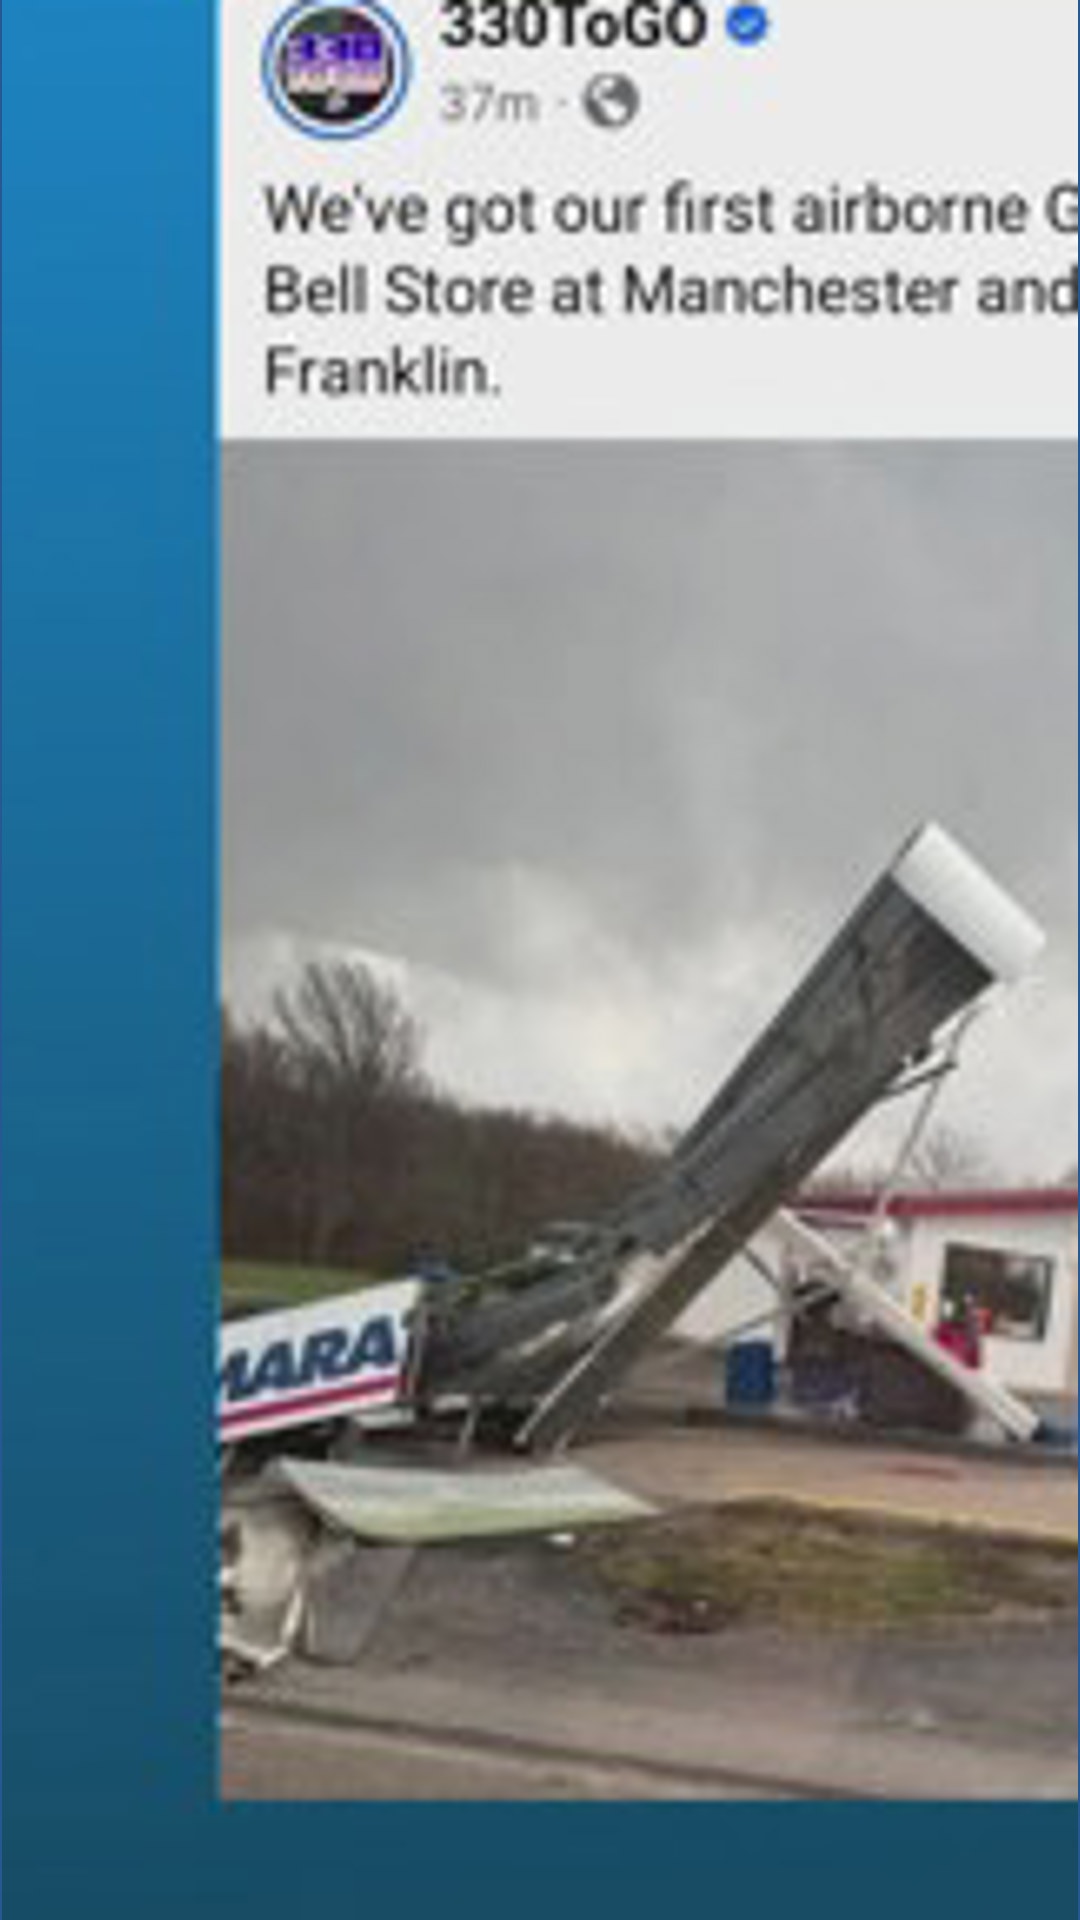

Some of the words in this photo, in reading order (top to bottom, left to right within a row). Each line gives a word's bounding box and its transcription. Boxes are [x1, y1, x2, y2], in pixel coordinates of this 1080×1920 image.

[440, 0, 707, 48] 330ToGO
[440, 84, 539, 121] 37m
[264, 184, 428, 234] We've
[445, 189, 536, 245] got
[553, 193, 645, 234] our
[664, 179, 774, 234] first
[792, 183, 1029, 234] airborne
[265, 263, 366, 314] Bell
[385, 264, 534, 315] Store
[551, 270, 602, 314] at
[624, 264, 959, 314] Manchester
[977, 264, 1079, 315] and
[265, 345, 502, 396] Franklin.
